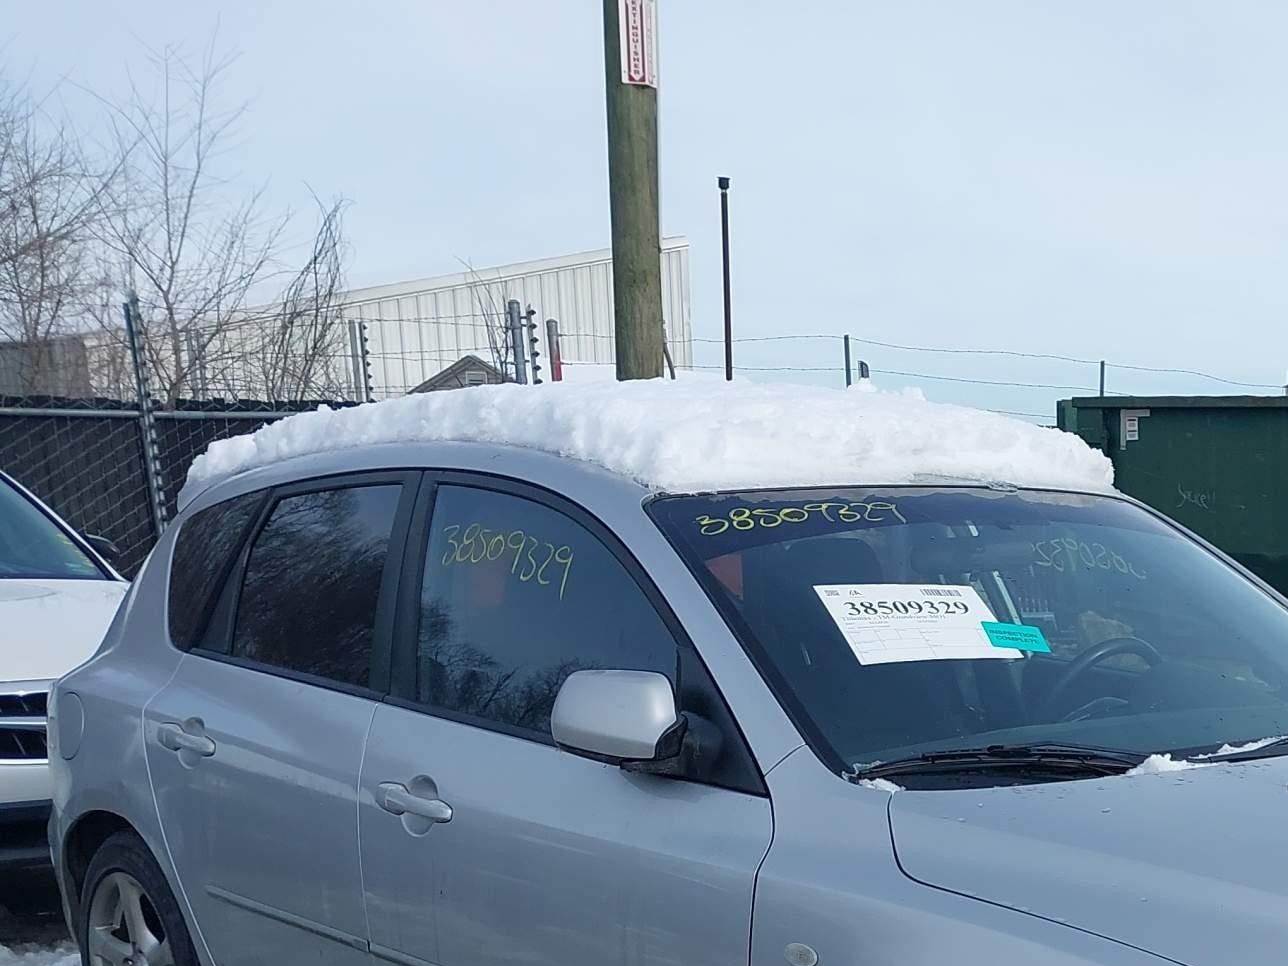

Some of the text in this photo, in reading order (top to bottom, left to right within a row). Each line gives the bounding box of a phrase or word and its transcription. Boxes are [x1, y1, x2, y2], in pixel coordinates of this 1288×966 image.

[695, 502, 907, 535] 38509329
[441, 522, 573, 600] 38509329
[842, 600, 969, 616] 38509329
